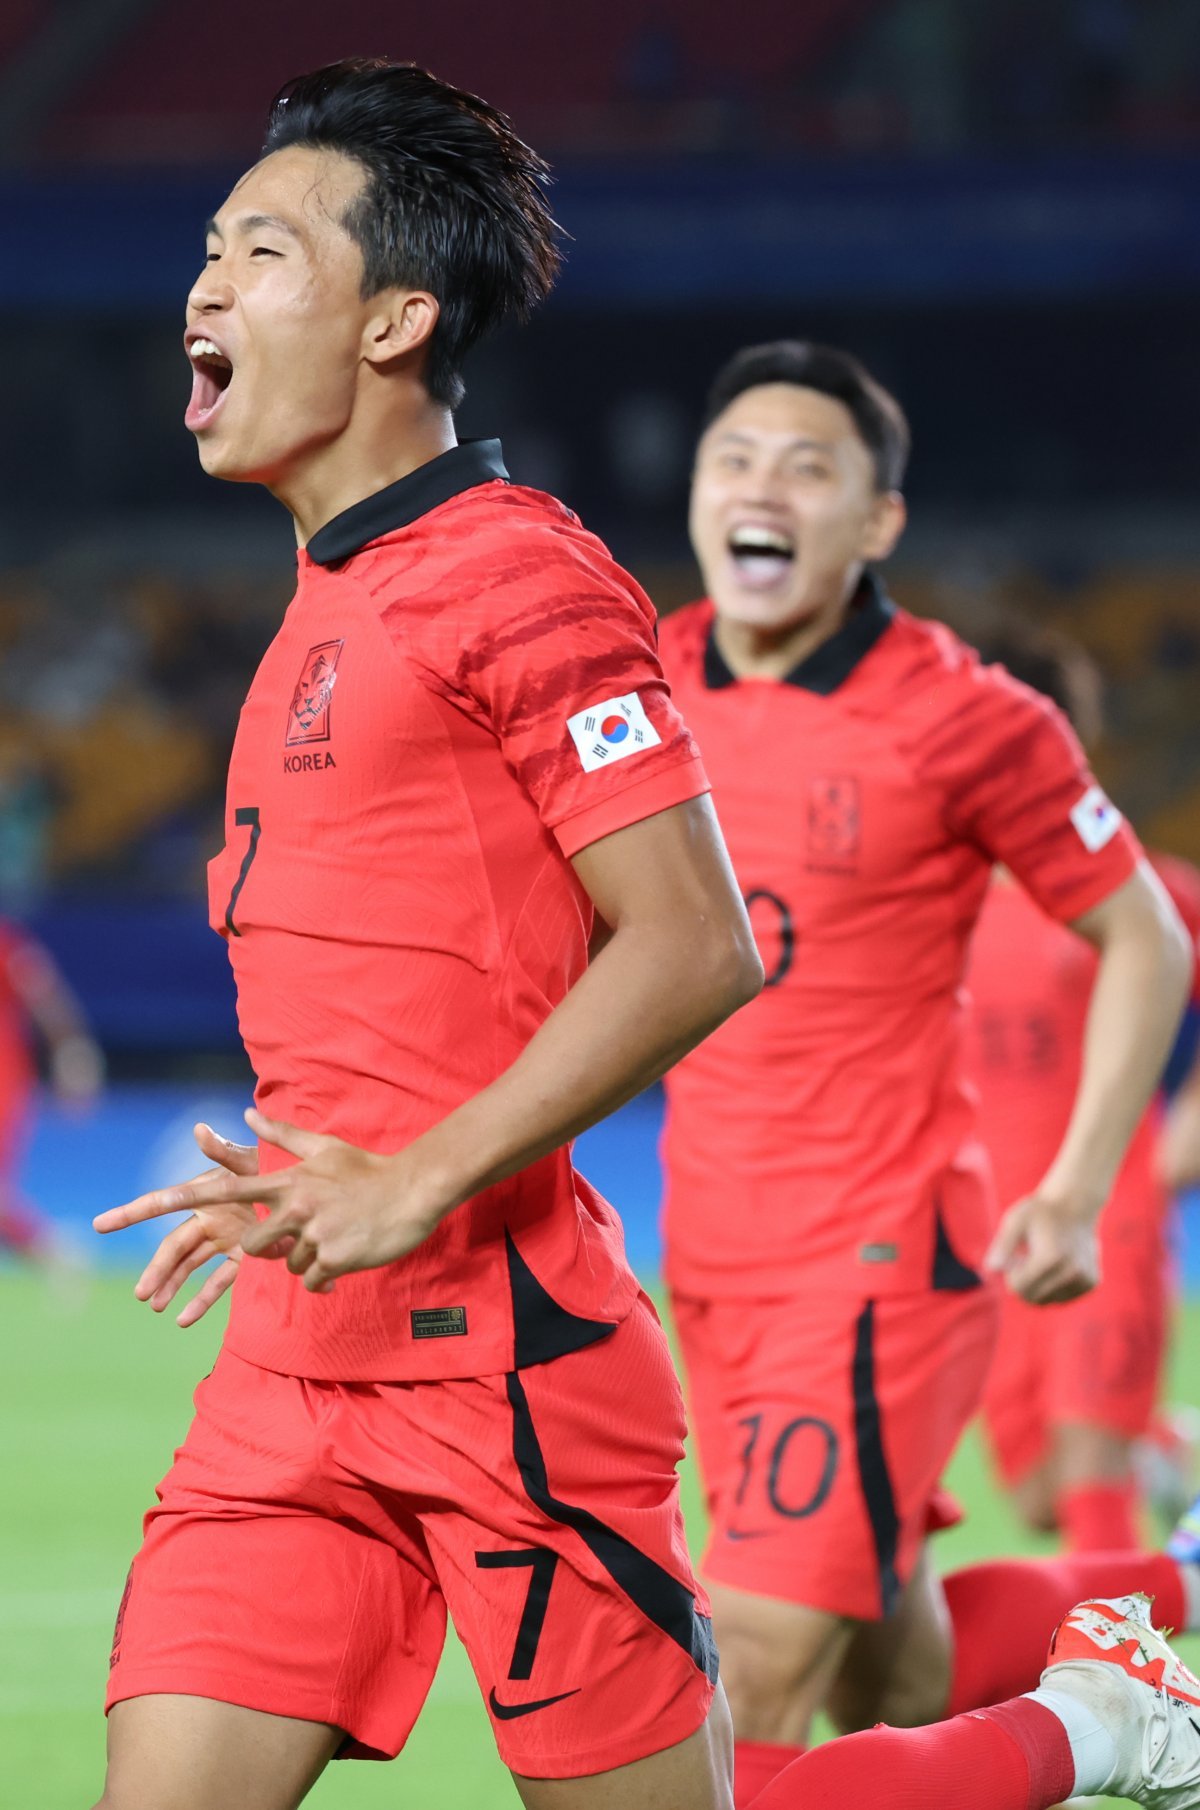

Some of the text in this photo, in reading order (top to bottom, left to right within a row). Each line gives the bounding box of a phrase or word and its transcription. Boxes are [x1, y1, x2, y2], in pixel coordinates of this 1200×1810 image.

[283, 751, 337, 774] KOREA
[225, 807, 262, 937] 7
[737, 1414, 839, 1520] 10
[474, 1546, 560, 1681] 7
